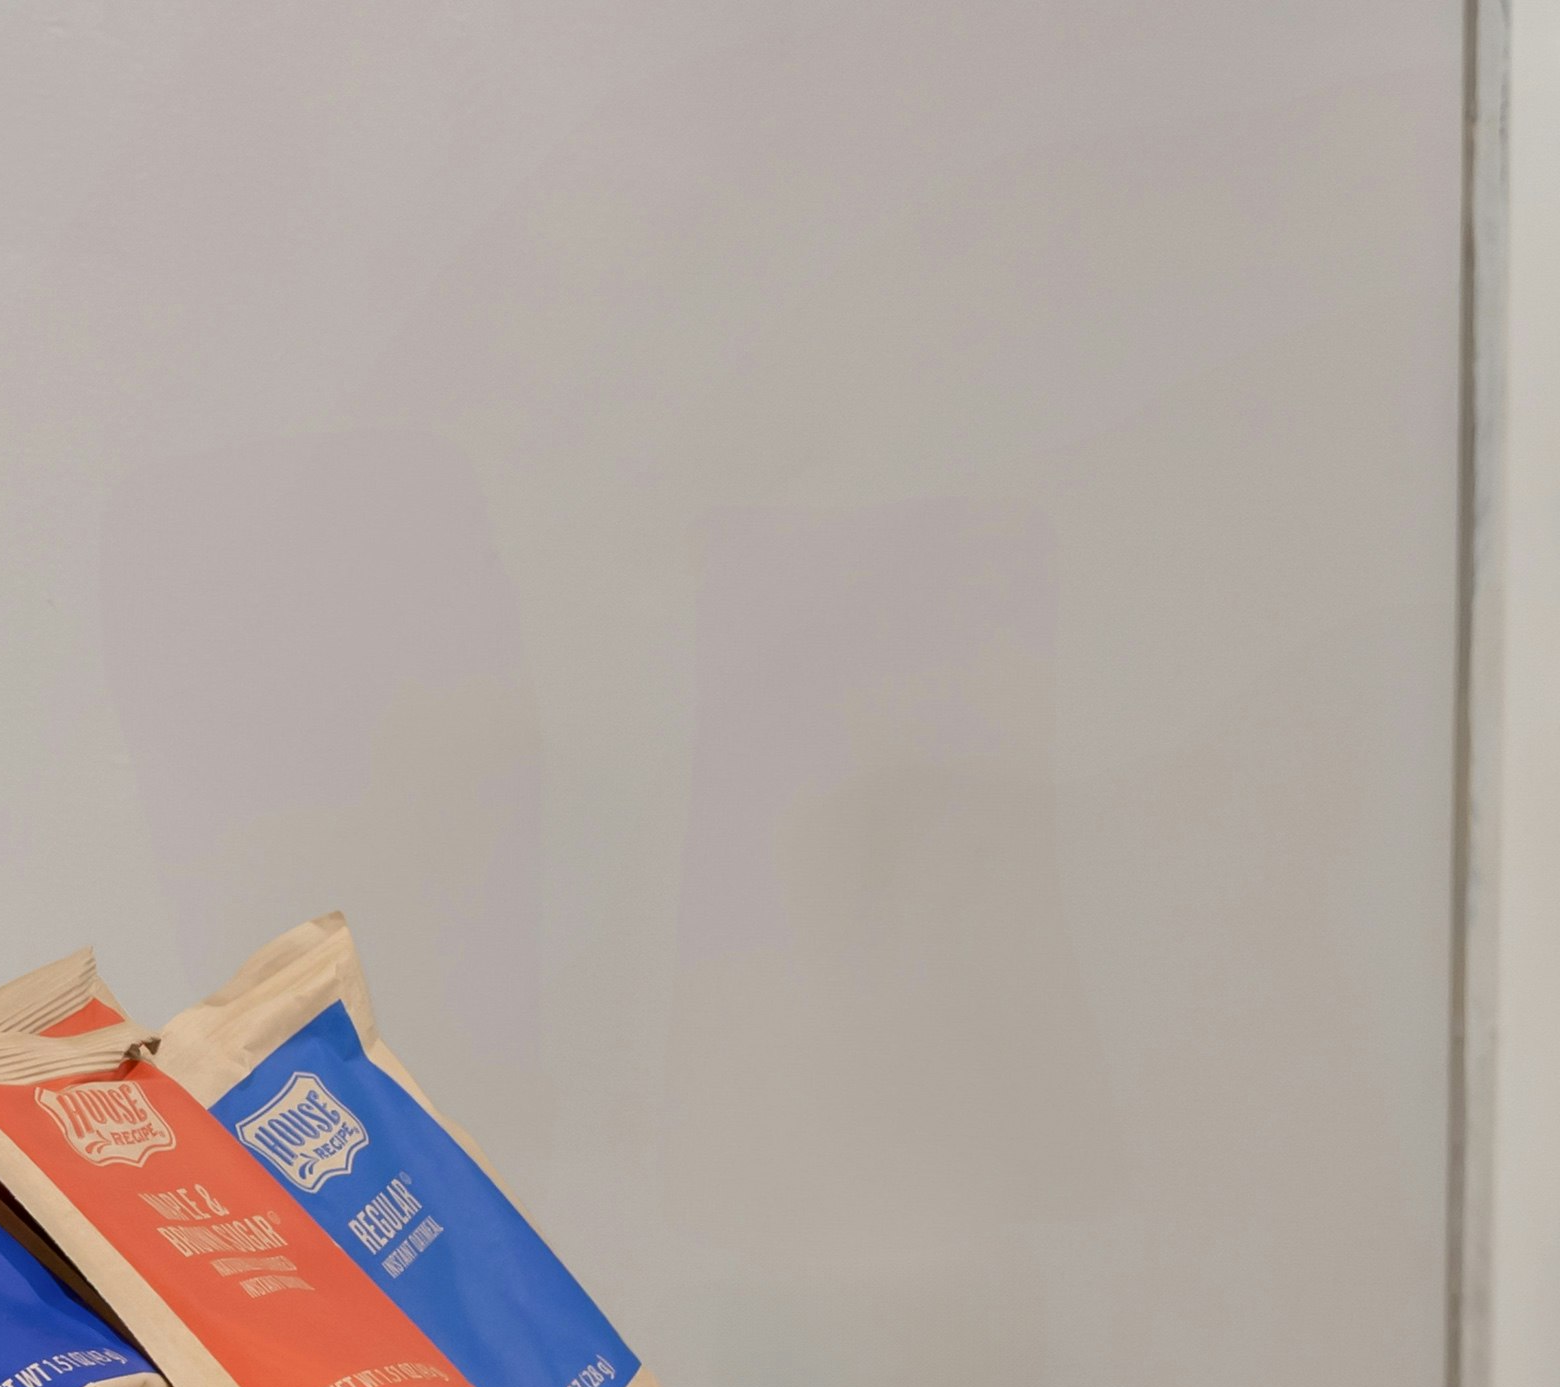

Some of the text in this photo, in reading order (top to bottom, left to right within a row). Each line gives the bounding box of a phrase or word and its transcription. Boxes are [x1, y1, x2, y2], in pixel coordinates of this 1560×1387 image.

[56, 1084, 148, 1139] HOUSE
[111, 1123, 158, 1146] RECIPE
[254, 1090, 341, 1167] HOUSE
[313, 1121, 354, 1160] RECIPE
[194, 1183, 230, 1217] &
[348, 1178, 423, 1256] REGULAR
